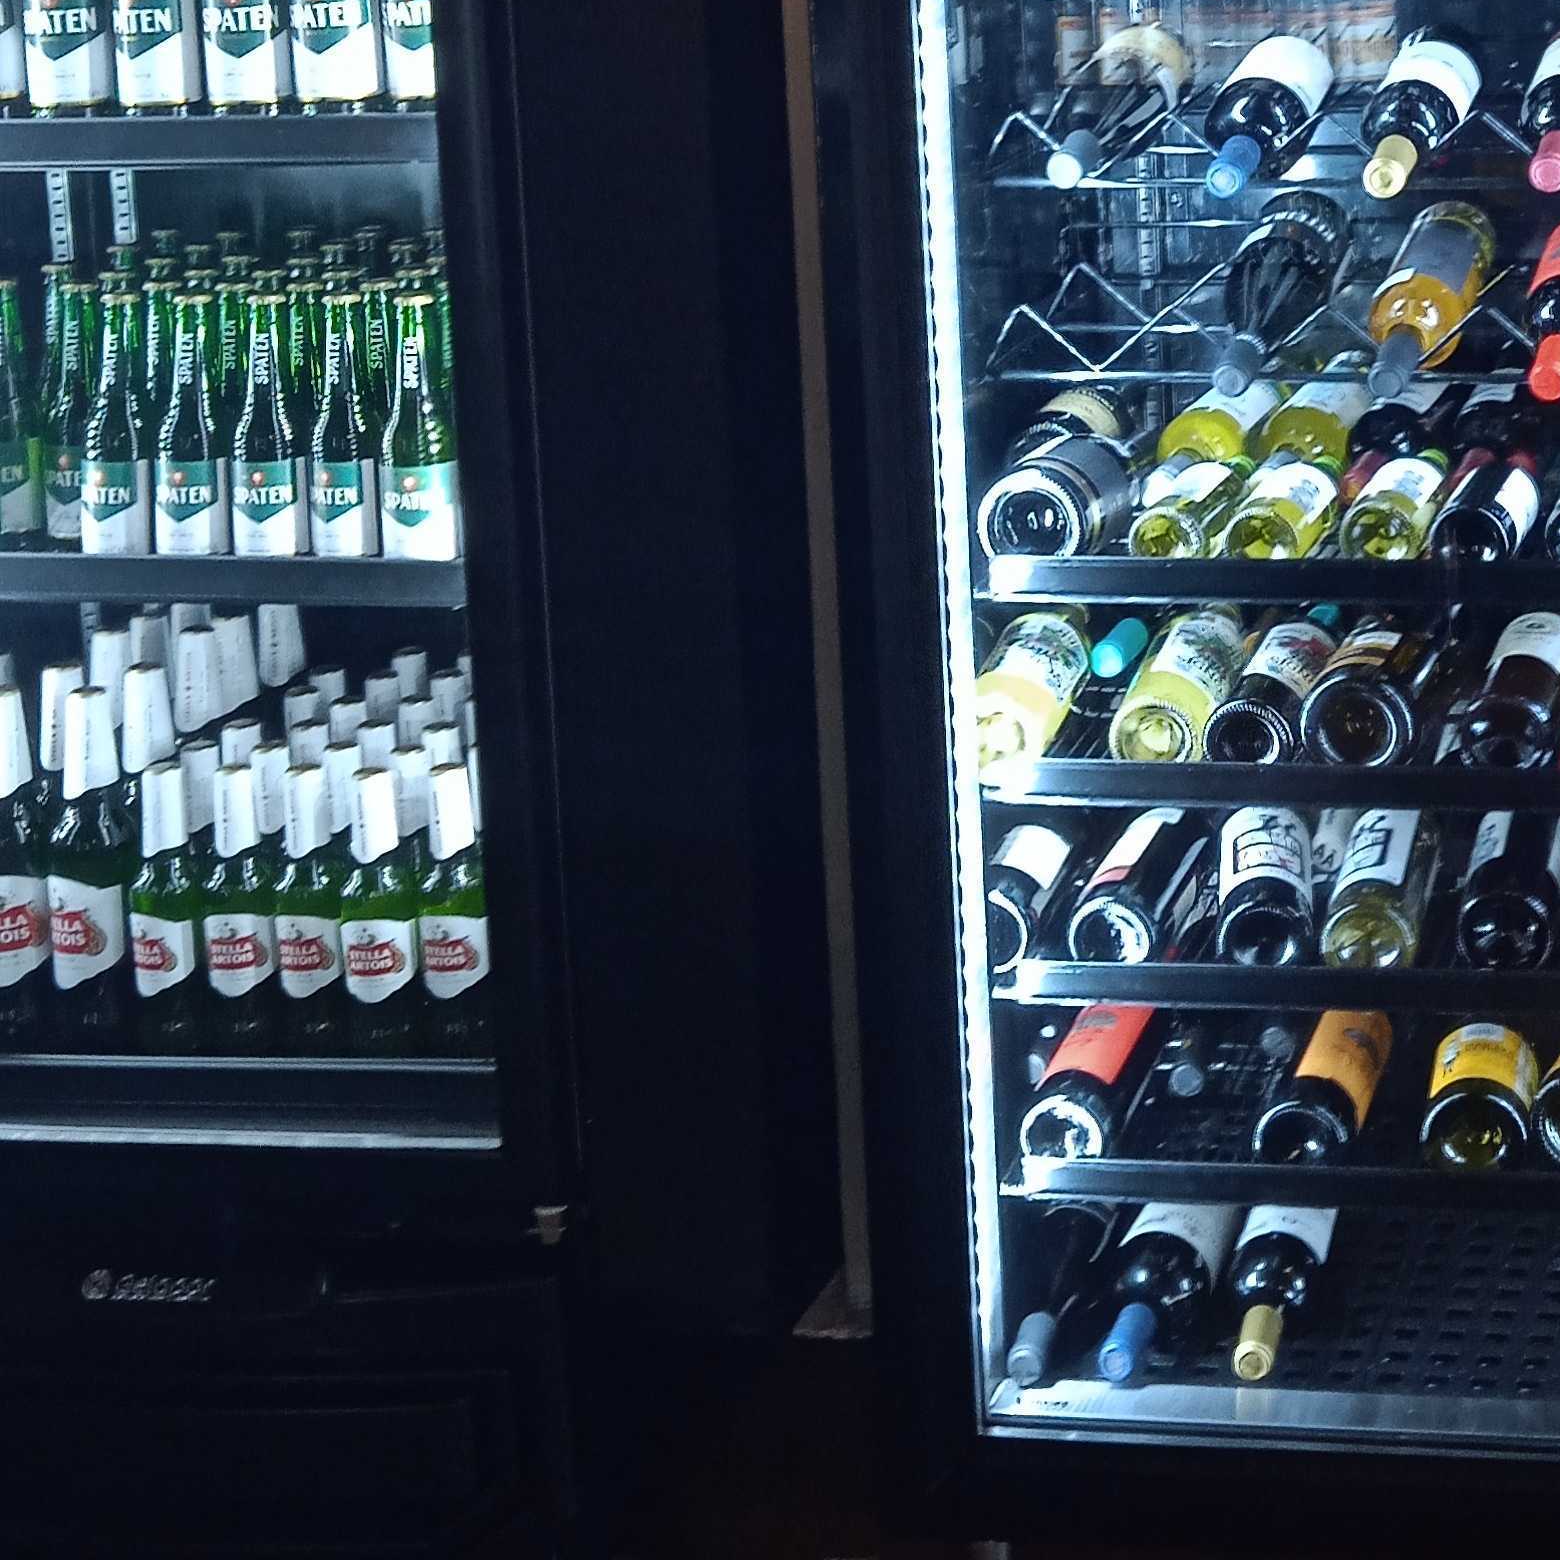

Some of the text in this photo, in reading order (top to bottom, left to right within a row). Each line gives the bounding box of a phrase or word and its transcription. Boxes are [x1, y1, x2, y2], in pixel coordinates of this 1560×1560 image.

[203, 3, 279, 32] SPATEN
[104, 333, 119, 385] SPATEN
[178, 333, 194, 385] SPATEN
[224, 320, 237, 370] SPATEN
[255, 333, 270, 385] SPATEN
[328, 333, 341, 385] SPATEN
[369, 319, 384, 370] SPATEN
[234, 485, 293, 505] SPATEN
